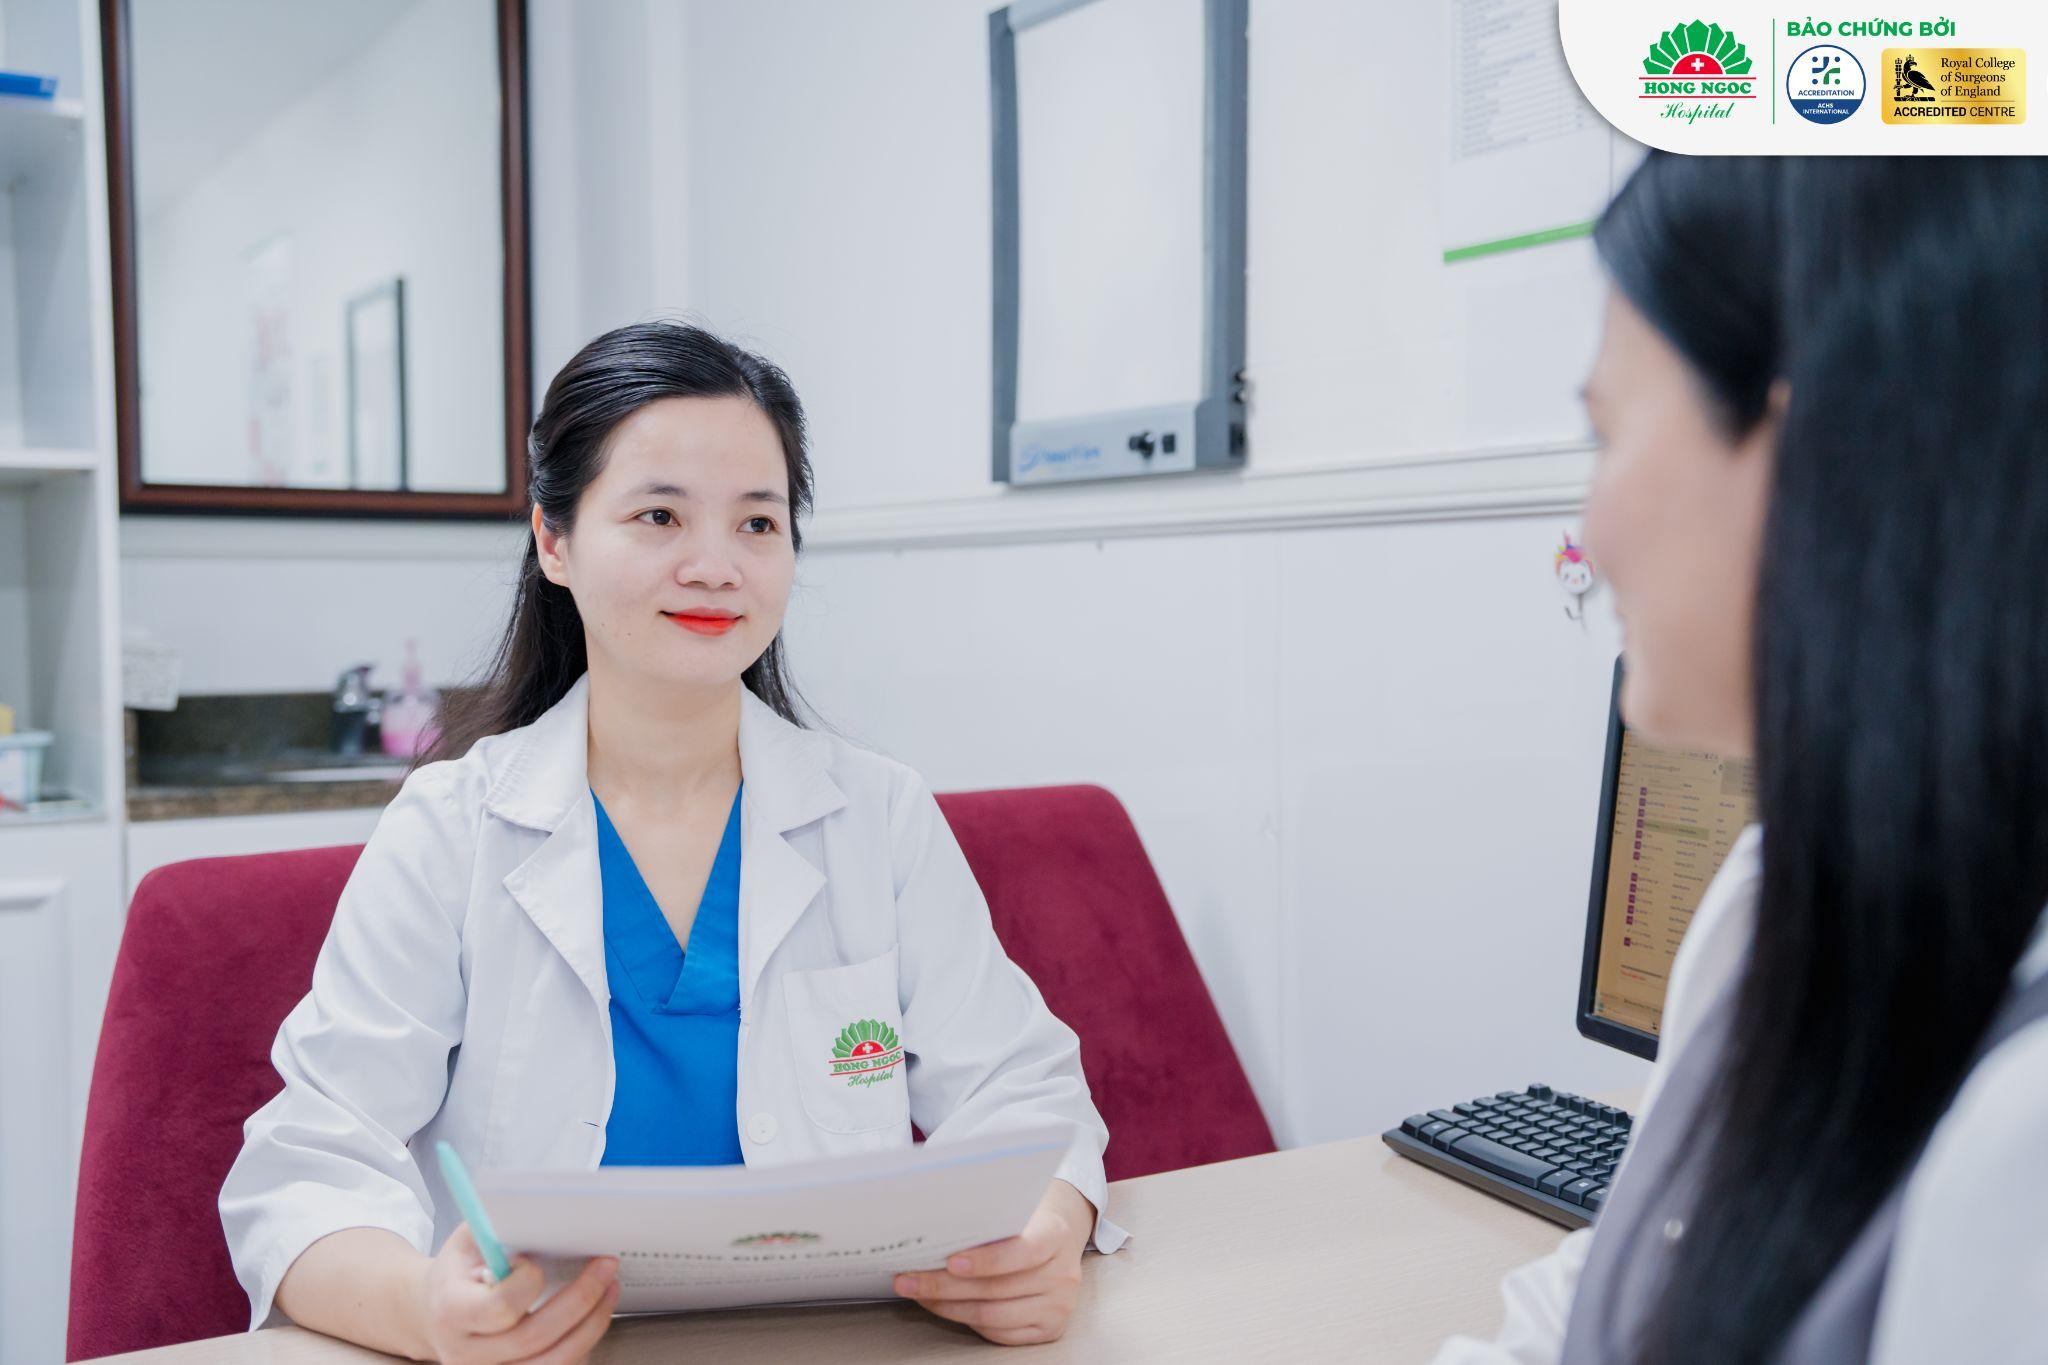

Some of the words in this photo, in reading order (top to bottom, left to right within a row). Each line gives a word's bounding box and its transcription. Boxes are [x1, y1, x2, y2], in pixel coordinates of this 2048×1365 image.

[833, 1060, 870, 1073] HONG
[871, 1051, 901, 1068] NGOC
[847, 1066, 895, 1088] Hospital
